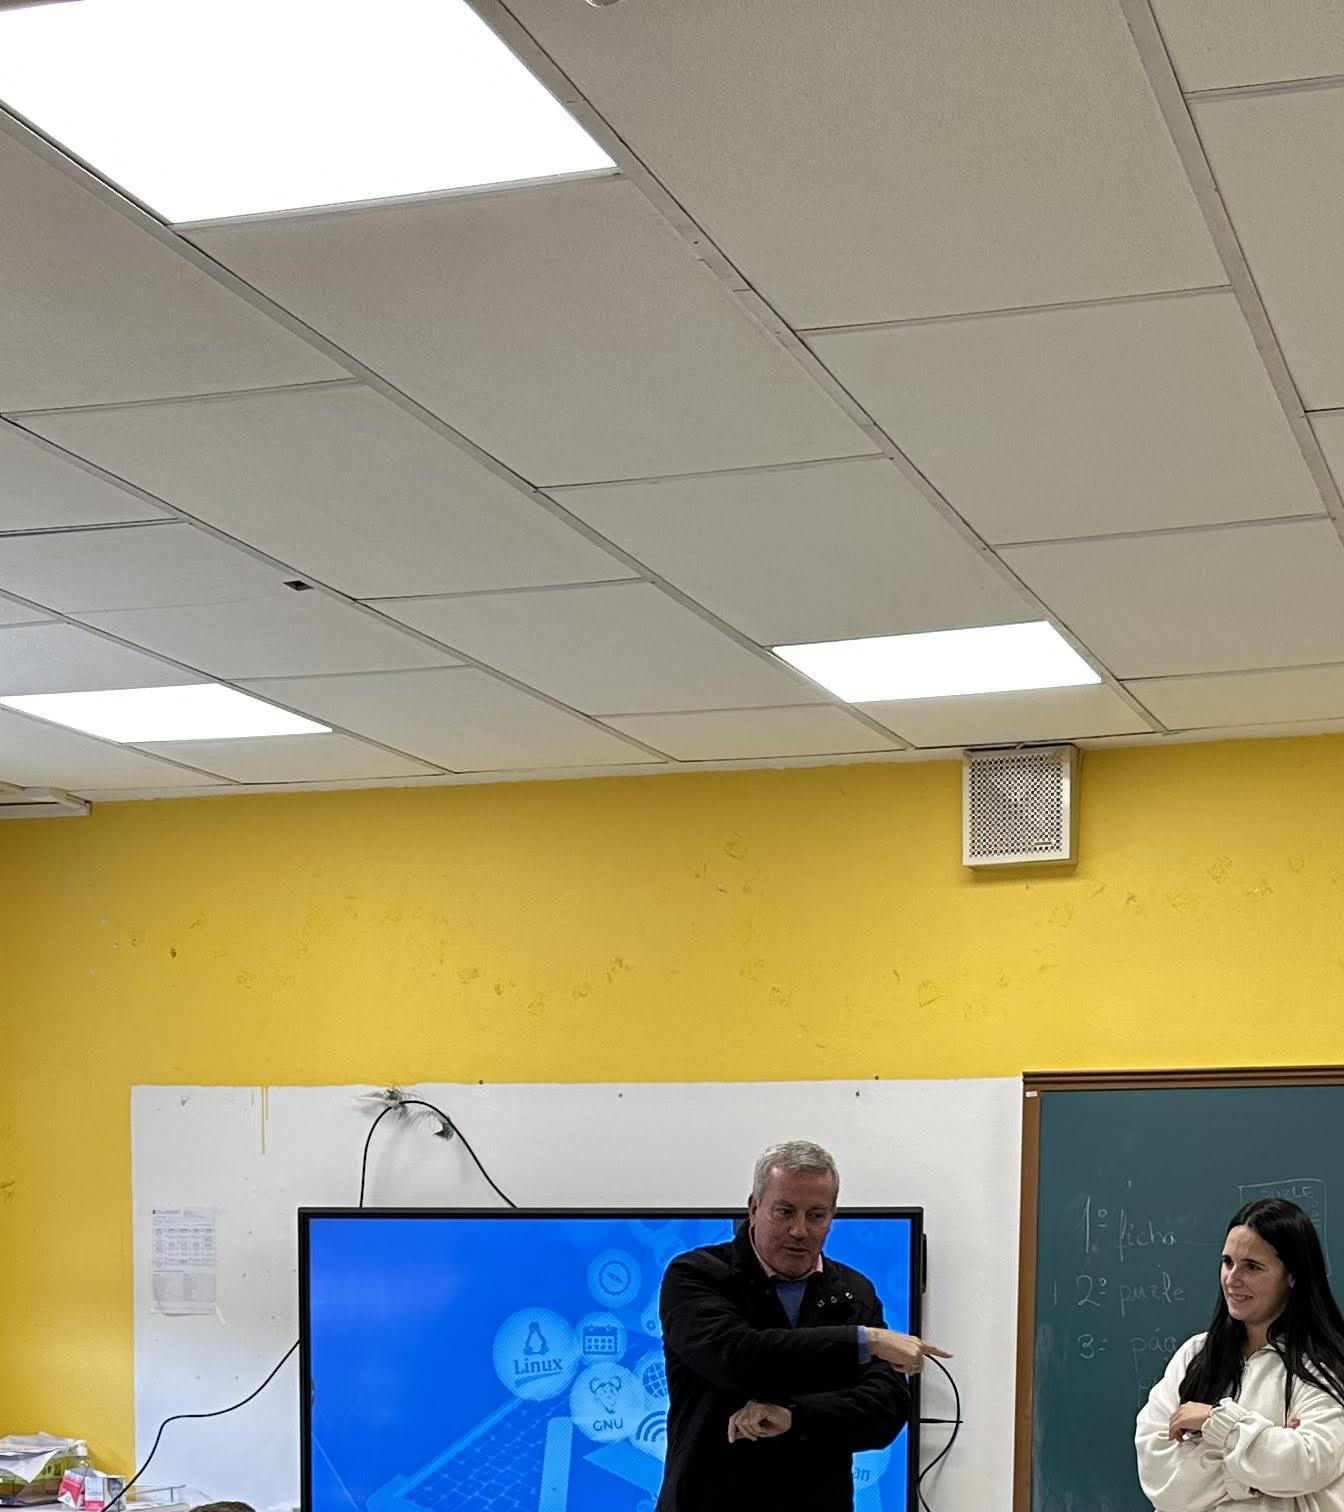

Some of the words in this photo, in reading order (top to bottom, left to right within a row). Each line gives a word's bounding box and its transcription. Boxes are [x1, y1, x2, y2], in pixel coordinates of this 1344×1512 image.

[1117, 1208, 1177, 1263] ficha
[513, 1357, 564, 1375] Linux
[592, 1418, 624, 1432] GNU
